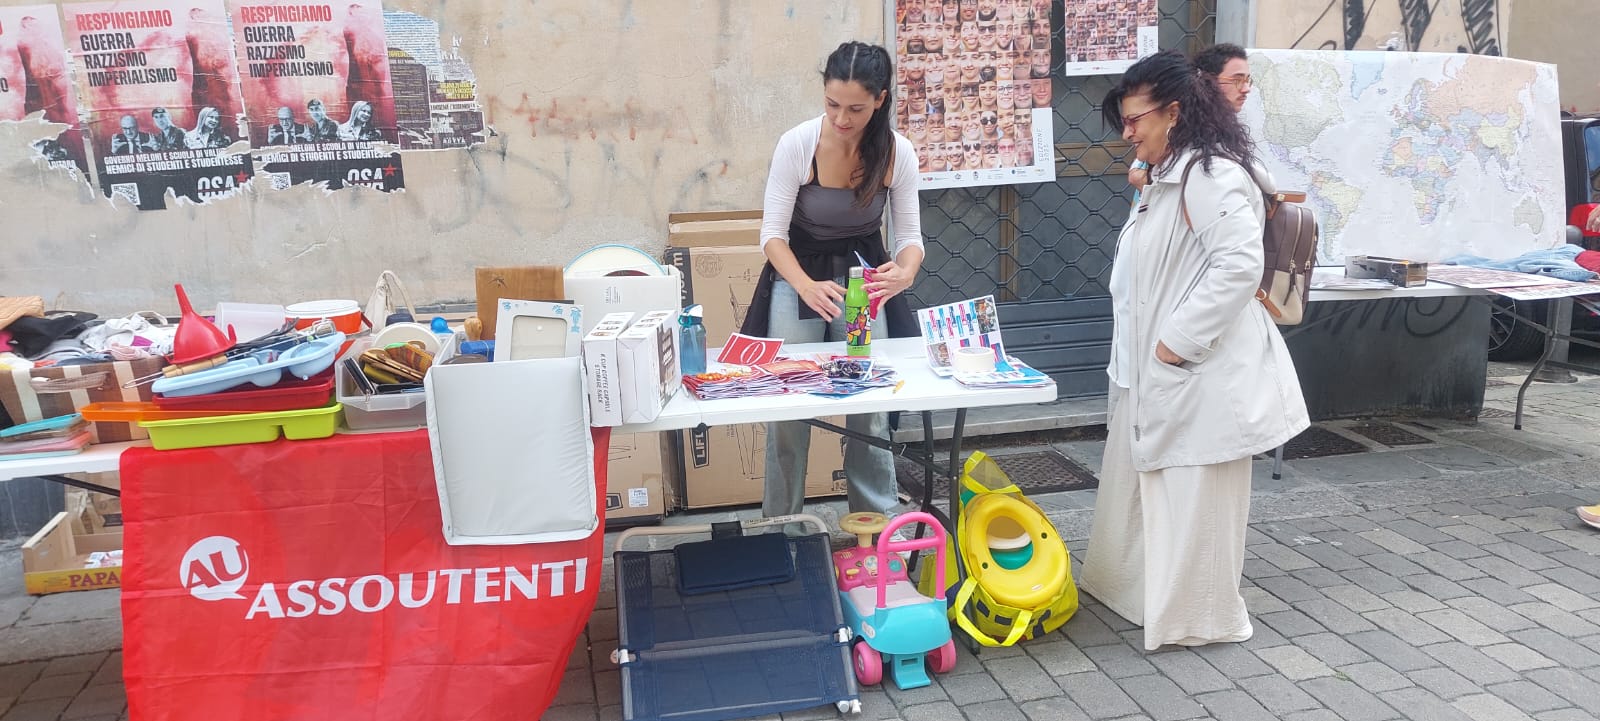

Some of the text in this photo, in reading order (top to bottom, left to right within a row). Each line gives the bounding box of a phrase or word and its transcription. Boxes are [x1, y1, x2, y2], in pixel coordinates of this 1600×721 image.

[75, 9, 173, 31] RESPINGIAMO
[241, 5, 333, 24] RESPINGIAMO
[80, 32, 136, 51] GUERRA
[244, 25, 296, 43] GUERRA
[83, 51, 147, 69] RAZZISMO
[246, 44, 306, 61] RAZZISMO
[87, 67, 178, 87] IMPERIALISMO
[249, 61, 334, 78] IMPERIALISMO
[316, 143, 322, 151] E
[322, 142, 347, 151] SCUOLA
[347, 142, 355, 150] DI
[103, 155, 135, 165] GOVERNO
[136, 153, 163, 163] MELONI
[163, 152, 168, 161] E
[169, 151, 195, 160] SCUOLA
[195, 150, 203, 158] DI
[105, 154, 244, 175] NEMICI DI STUDENTI E STUDENTESSE
[290, 151, 299, 161] DI
[300, 150, 335, 162] STUDENTI
[336, 150, 342, 160] E
[601, 369, 609, 389] COFFEE
[184, 545, 247, 590] AU
[68, 571, 120, 588] PAPA
[244, 557, 588, 620] ASSOUTENTI
